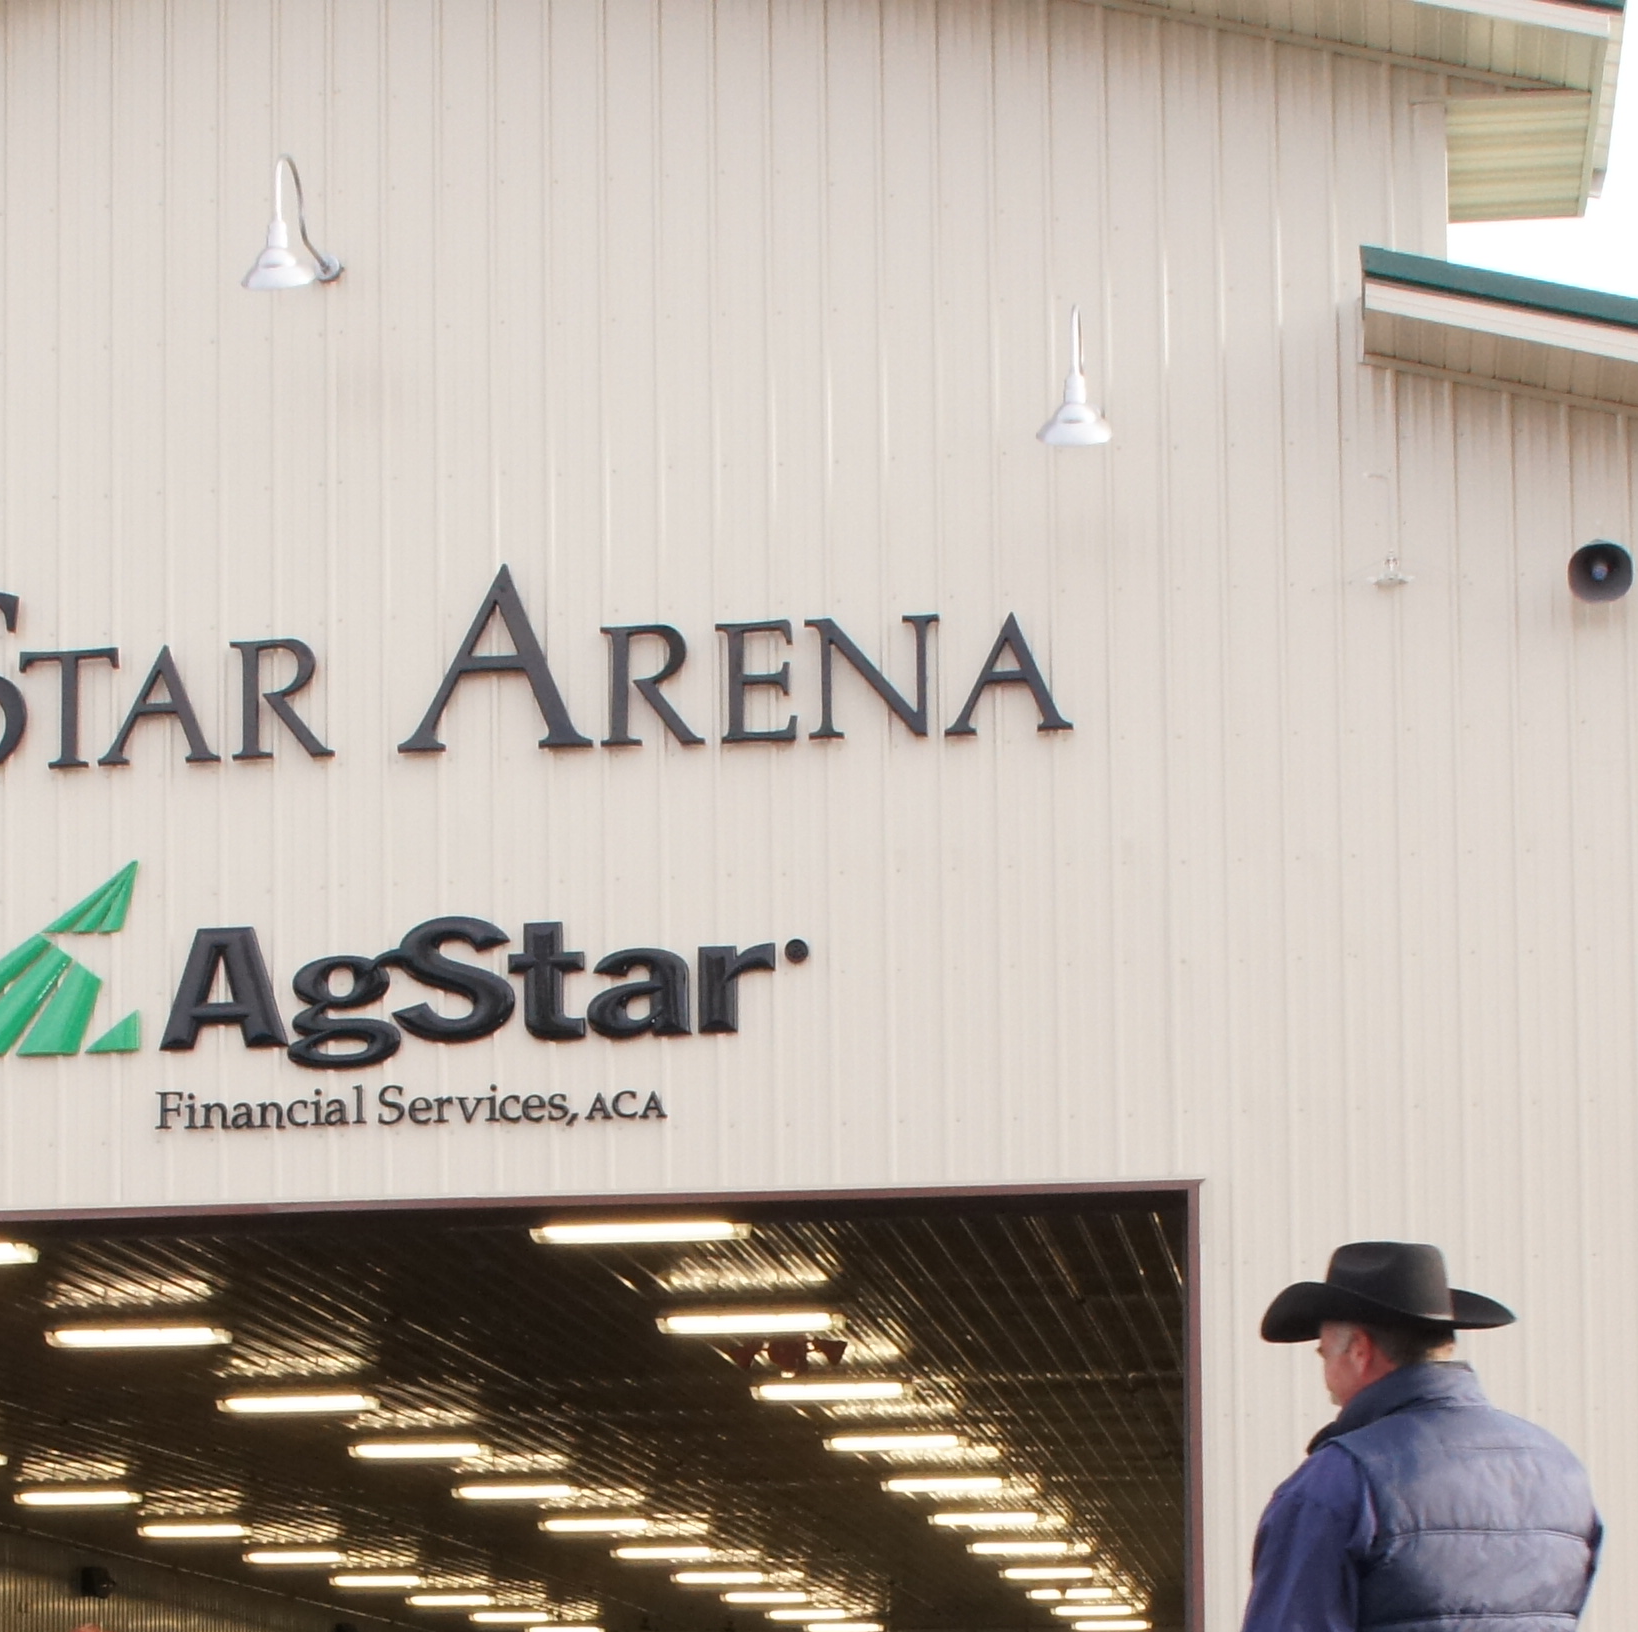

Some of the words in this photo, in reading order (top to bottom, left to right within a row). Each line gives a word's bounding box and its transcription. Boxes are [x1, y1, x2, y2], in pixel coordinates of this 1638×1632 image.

[397, 564, 1074, 756] ARENA
[159, 916, 776, 1072] AgStar
[155, 1085, 367, 1131] Financial
[377, 1084, 580, 1127] Services,
[584, 1090, 667, 1121] ACA
